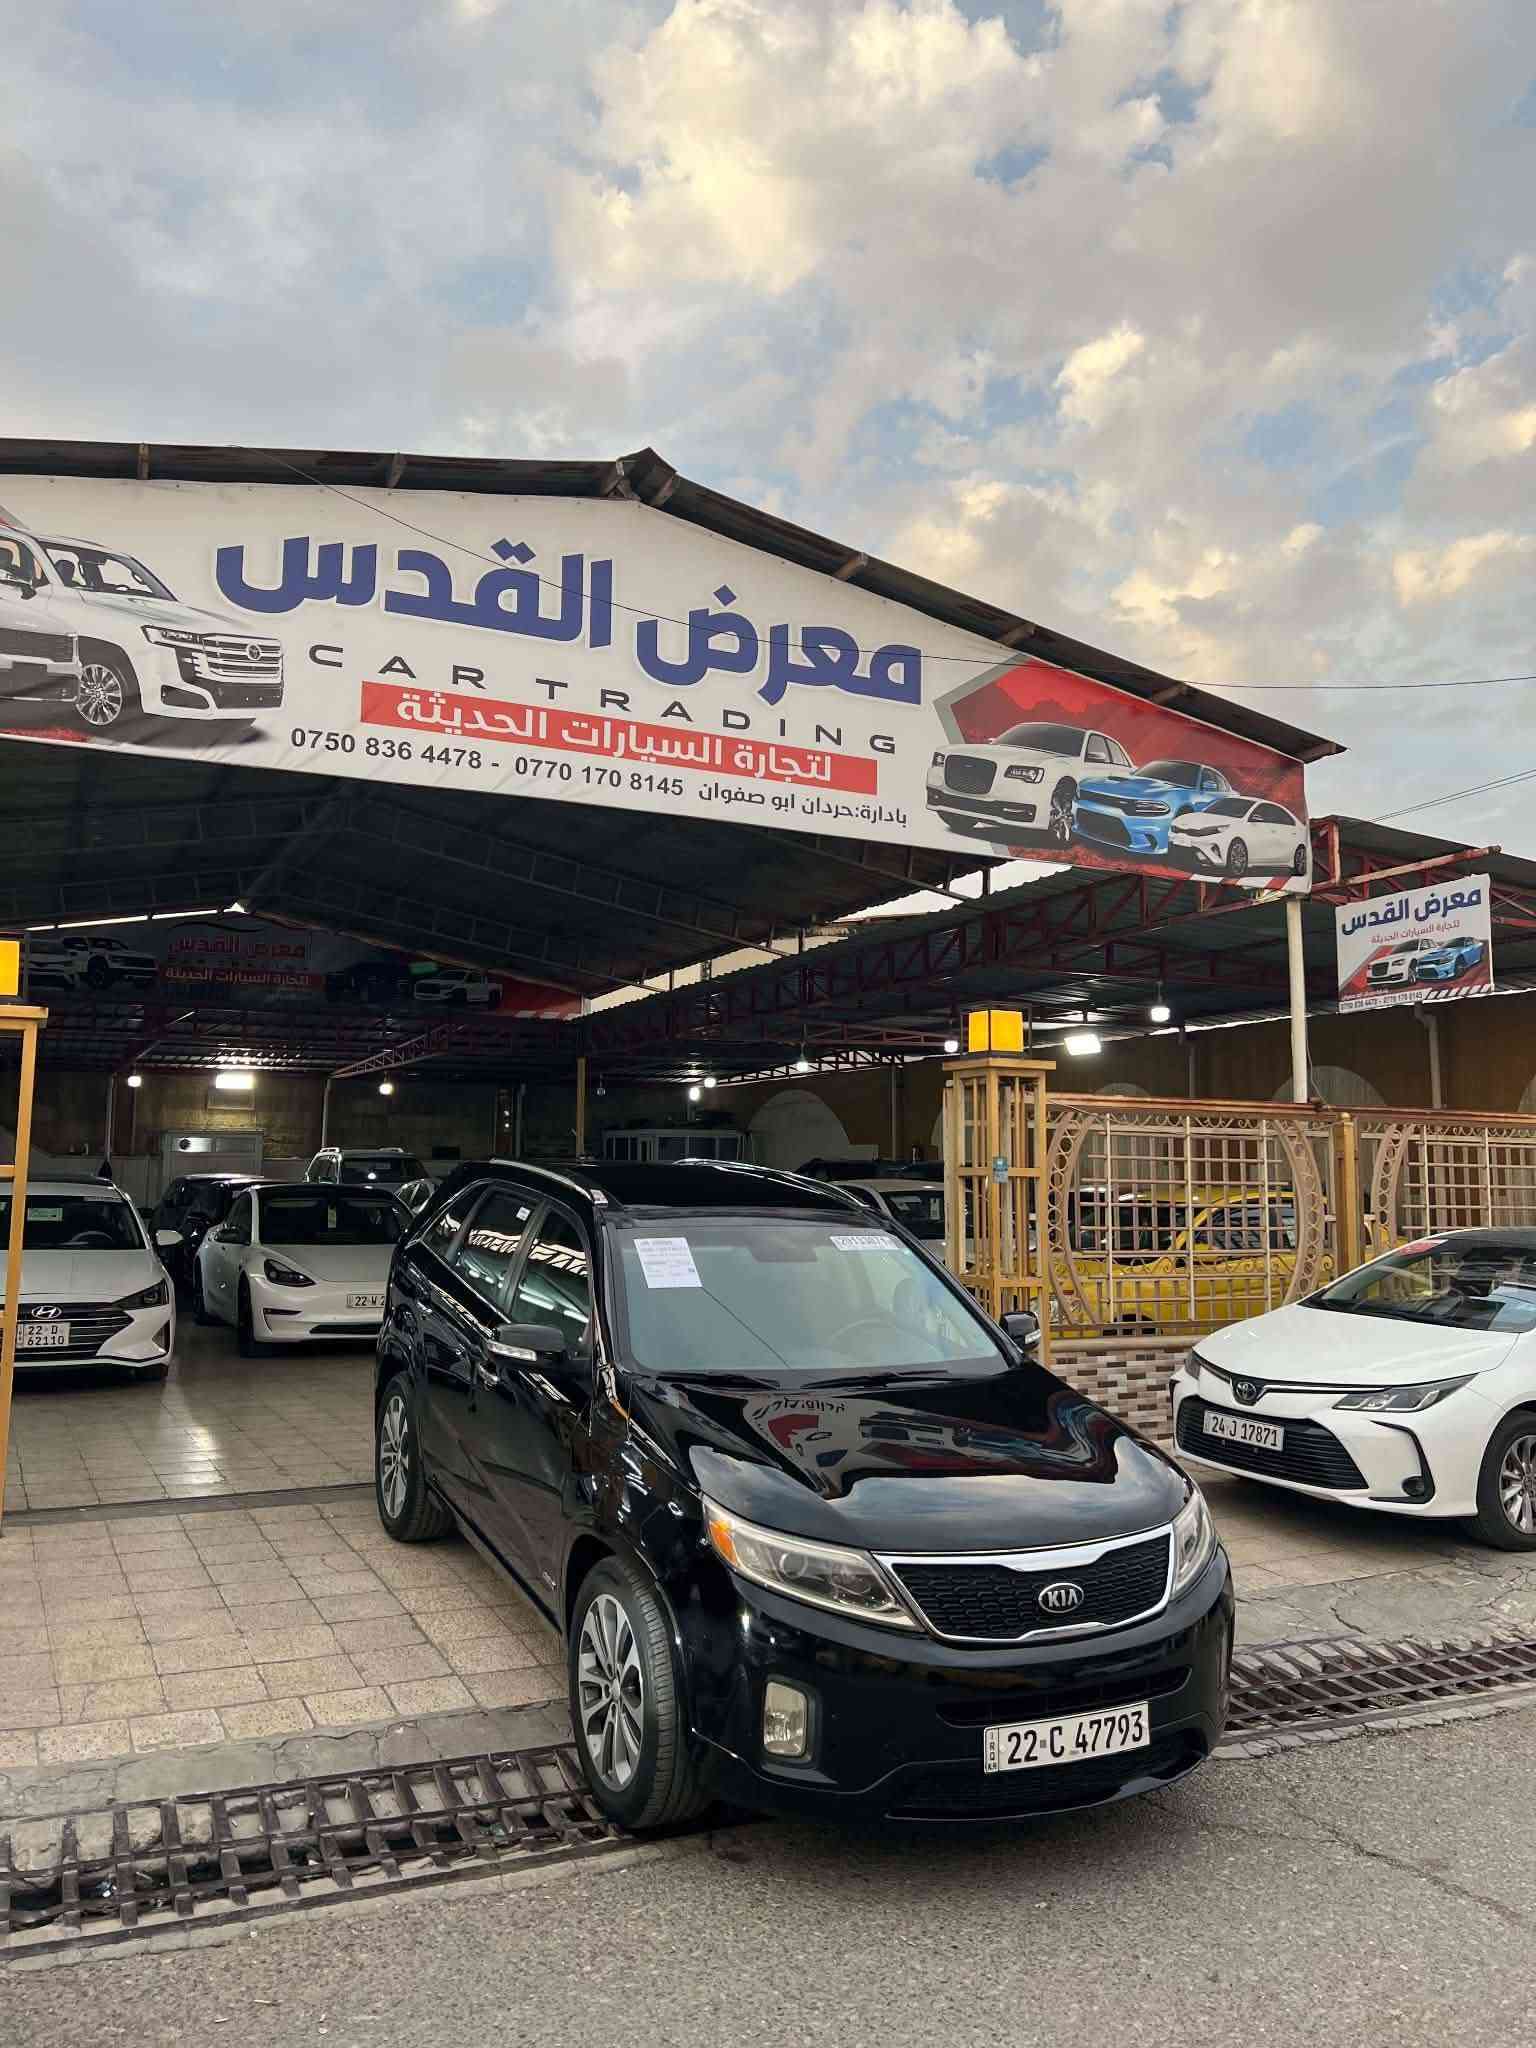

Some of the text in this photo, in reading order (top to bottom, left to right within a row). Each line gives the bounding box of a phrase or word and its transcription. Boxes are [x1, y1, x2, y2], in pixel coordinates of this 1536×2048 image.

[216, 536, 922, 705] معرض القدس
[309, 643, 896, 754] CAR TRADING
[397, 689, 832, 784] لتجارة السيارات الحديثة
[291, 727, 356, 753] 0750
[365, 736, 413, 761] 836
[420, 744, 482, 769] 4478
[515, 756, 572, 781] 0770
[581, 765, 622, 788] 170
[630, 772, 684, 797] 8145
[698, 782, 766, 806] صفوان
[1341, 889, 1482, 936] معرض القدس
[355, 1295, 367, 1306] 22
[27, 1335, 65, 1345] 62110
[28, 1325, 43, 1336] 22
[1211, 1416, 1278, 1447] 24 J 17871
[1047, 1588, 1078, 1608] KIA
[1007, 1710, 1144, 1765] 22 C 47793
